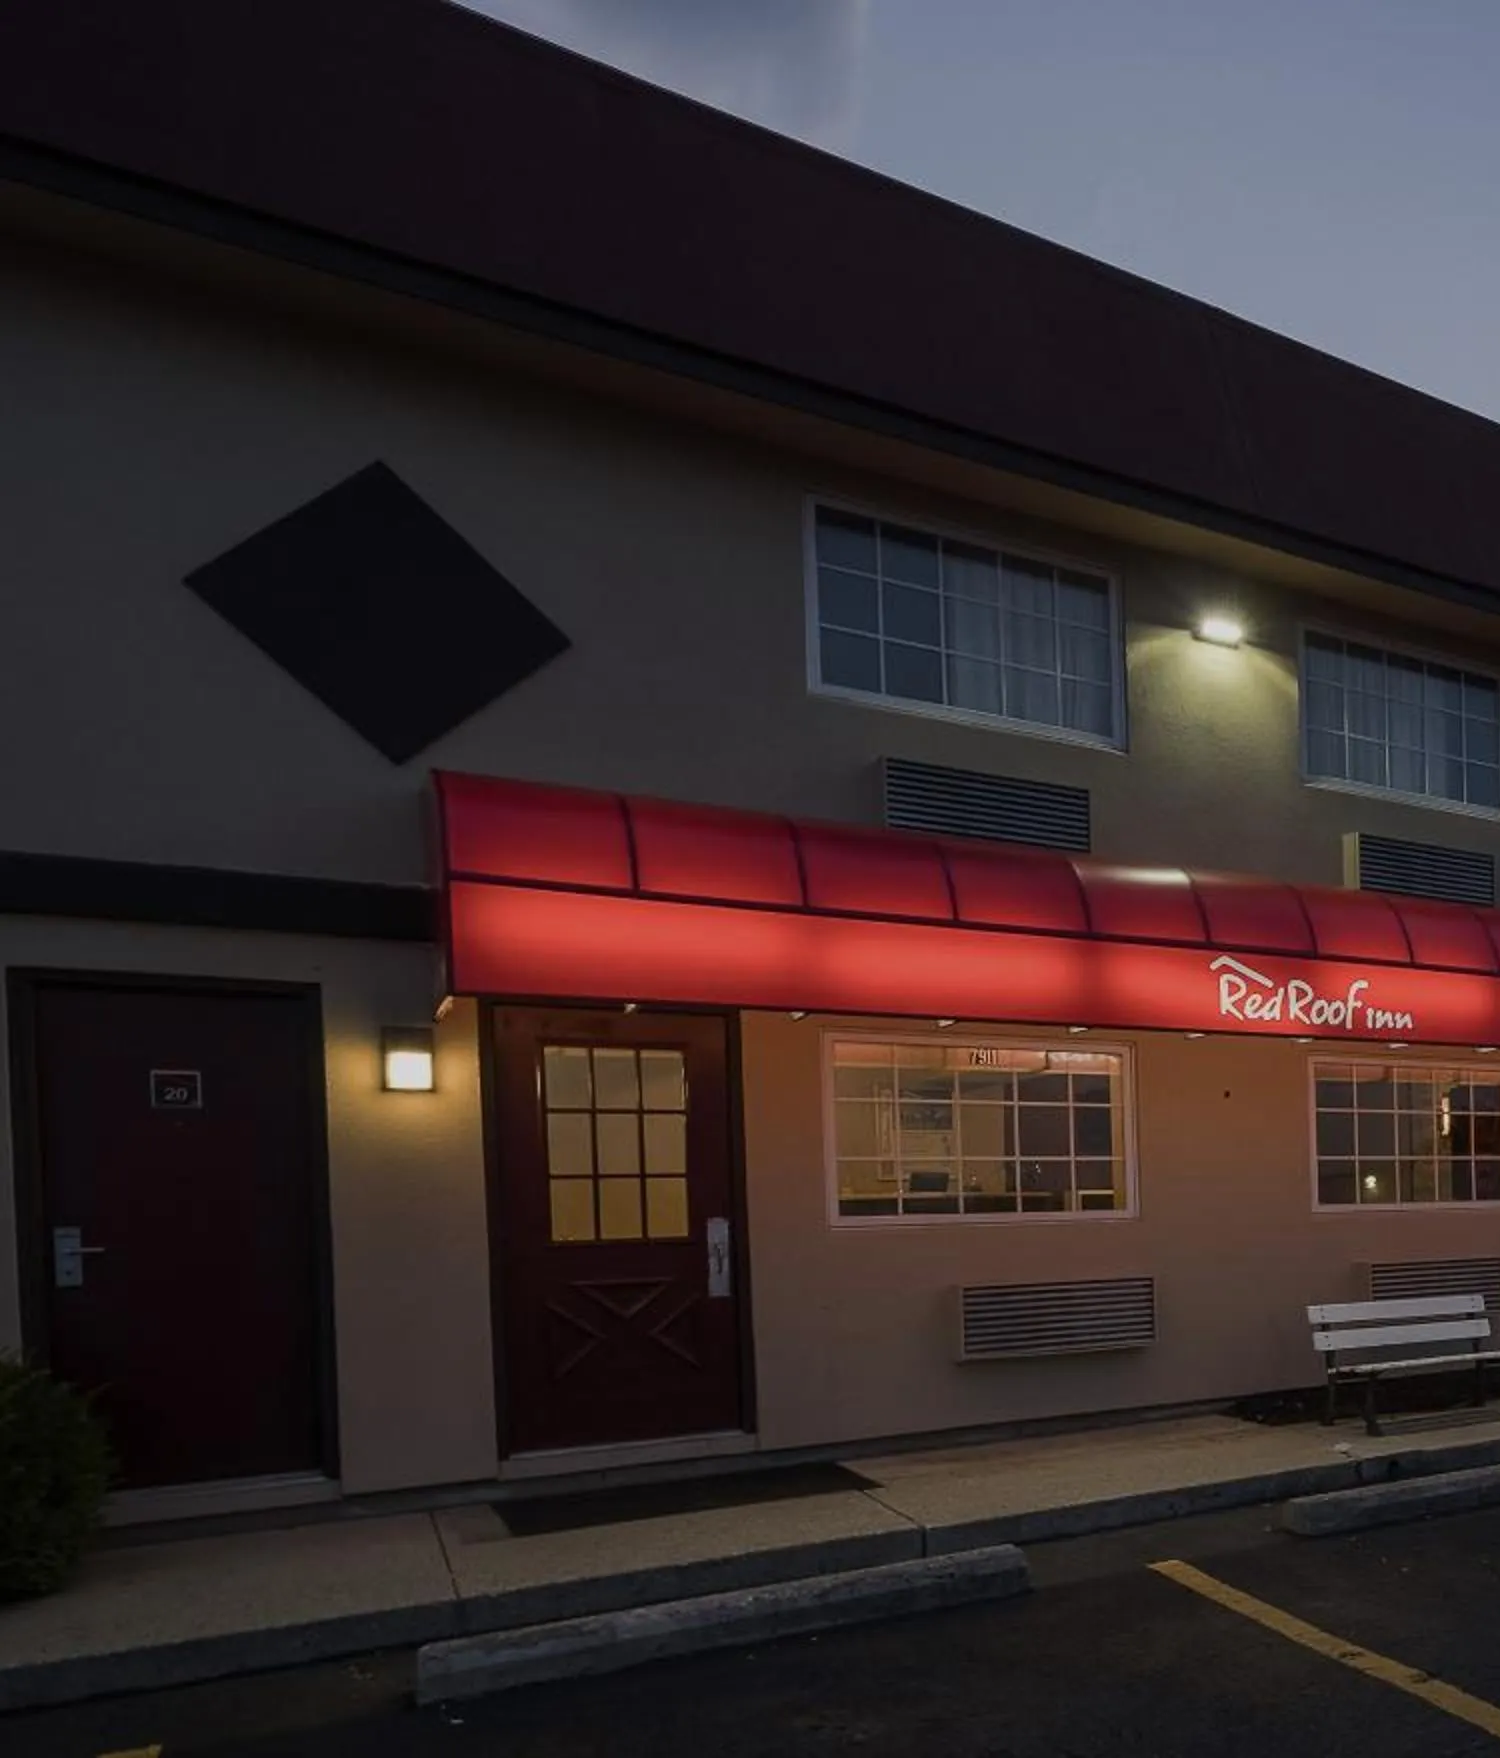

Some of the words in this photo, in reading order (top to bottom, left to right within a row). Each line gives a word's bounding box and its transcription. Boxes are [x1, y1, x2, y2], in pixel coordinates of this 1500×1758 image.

[1219, 973, 1285, 1021] Red
[1288, 979, 1369, 1030] Roof
[163, 1086, 189, 1102] 20
